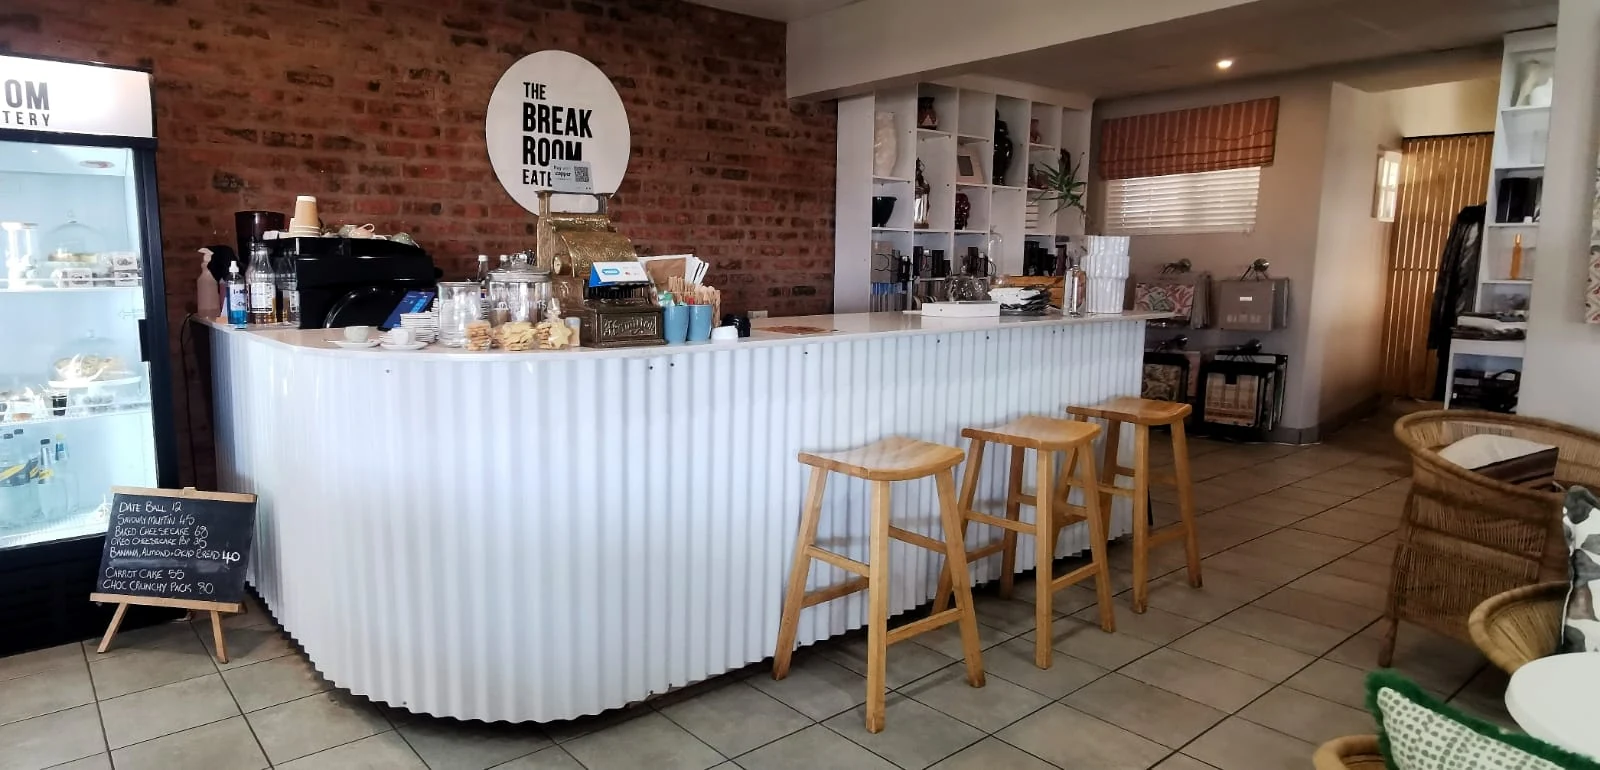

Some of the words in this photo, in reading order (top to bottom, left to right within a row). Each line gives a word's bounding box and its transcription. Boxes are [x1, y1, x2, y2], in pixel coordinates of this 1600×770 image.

[4, 79, 50, 111] OM
[523, 82, 547, 100] THE
[2, 110, 50, 127] TERY
[523, 102, 593, 138] BREAK
[523, 136, 582, 167] ROOM
[523, 169, 553, 187] EATE
[119, 502, 141, 512] DATE
[145, 502, 167, 512] BALL
[171, 502, 182, 512] 12
[178, 514, 195, 525] 45
[115, 526, 136, 537] BAKED
[139, 526, 190, 536] CHEESECAKE
[111, 538, 130, 546] OREO
[222, 551, 240, 564] 40
[105, 567, 138, 579] CARROT
[139, 568, 163, 579] CAKE
[167, 569, 185, 580] 55
[102, 579, 127, 590] CHOC
[129, 580, 167, 592] CRUNCHY
